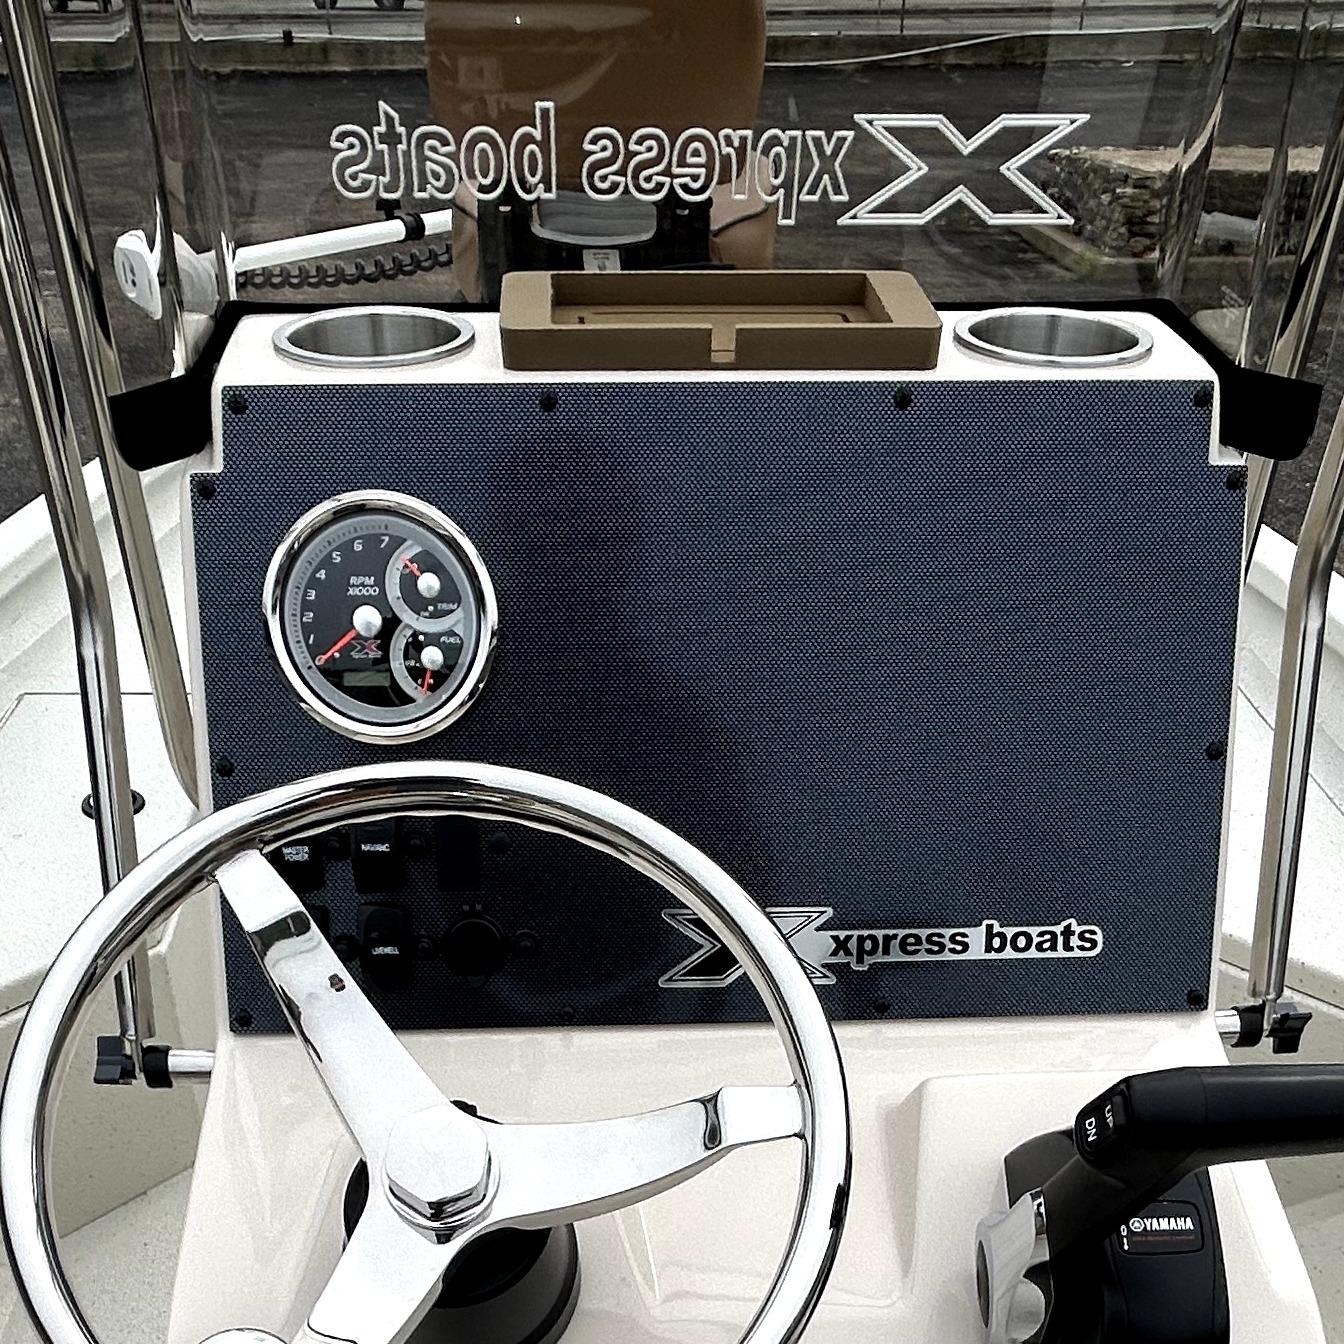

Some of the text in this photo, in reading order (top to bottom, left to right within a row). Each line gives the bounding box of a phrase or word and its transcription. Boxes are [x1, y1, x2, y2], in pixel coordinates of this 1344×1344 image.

[353, 539, 363, 551] 6
[380, 536, 389, 548] 7
[332, 551, 341, 563] 5
[315, 569, 327, 580] 4
[349, 576, 375, 585] RPM
[305, 589, 316, 600] 3
[302, 612, 314, 623] 2
[308, 634, 314, 645] 1
[828, 929, 970, 963] xpress
[981, 923, 1099, 955] boats
[1085, 1116, 1098, 1141] DN
[1143, 1216, 1194, 1231] YAMAHA
